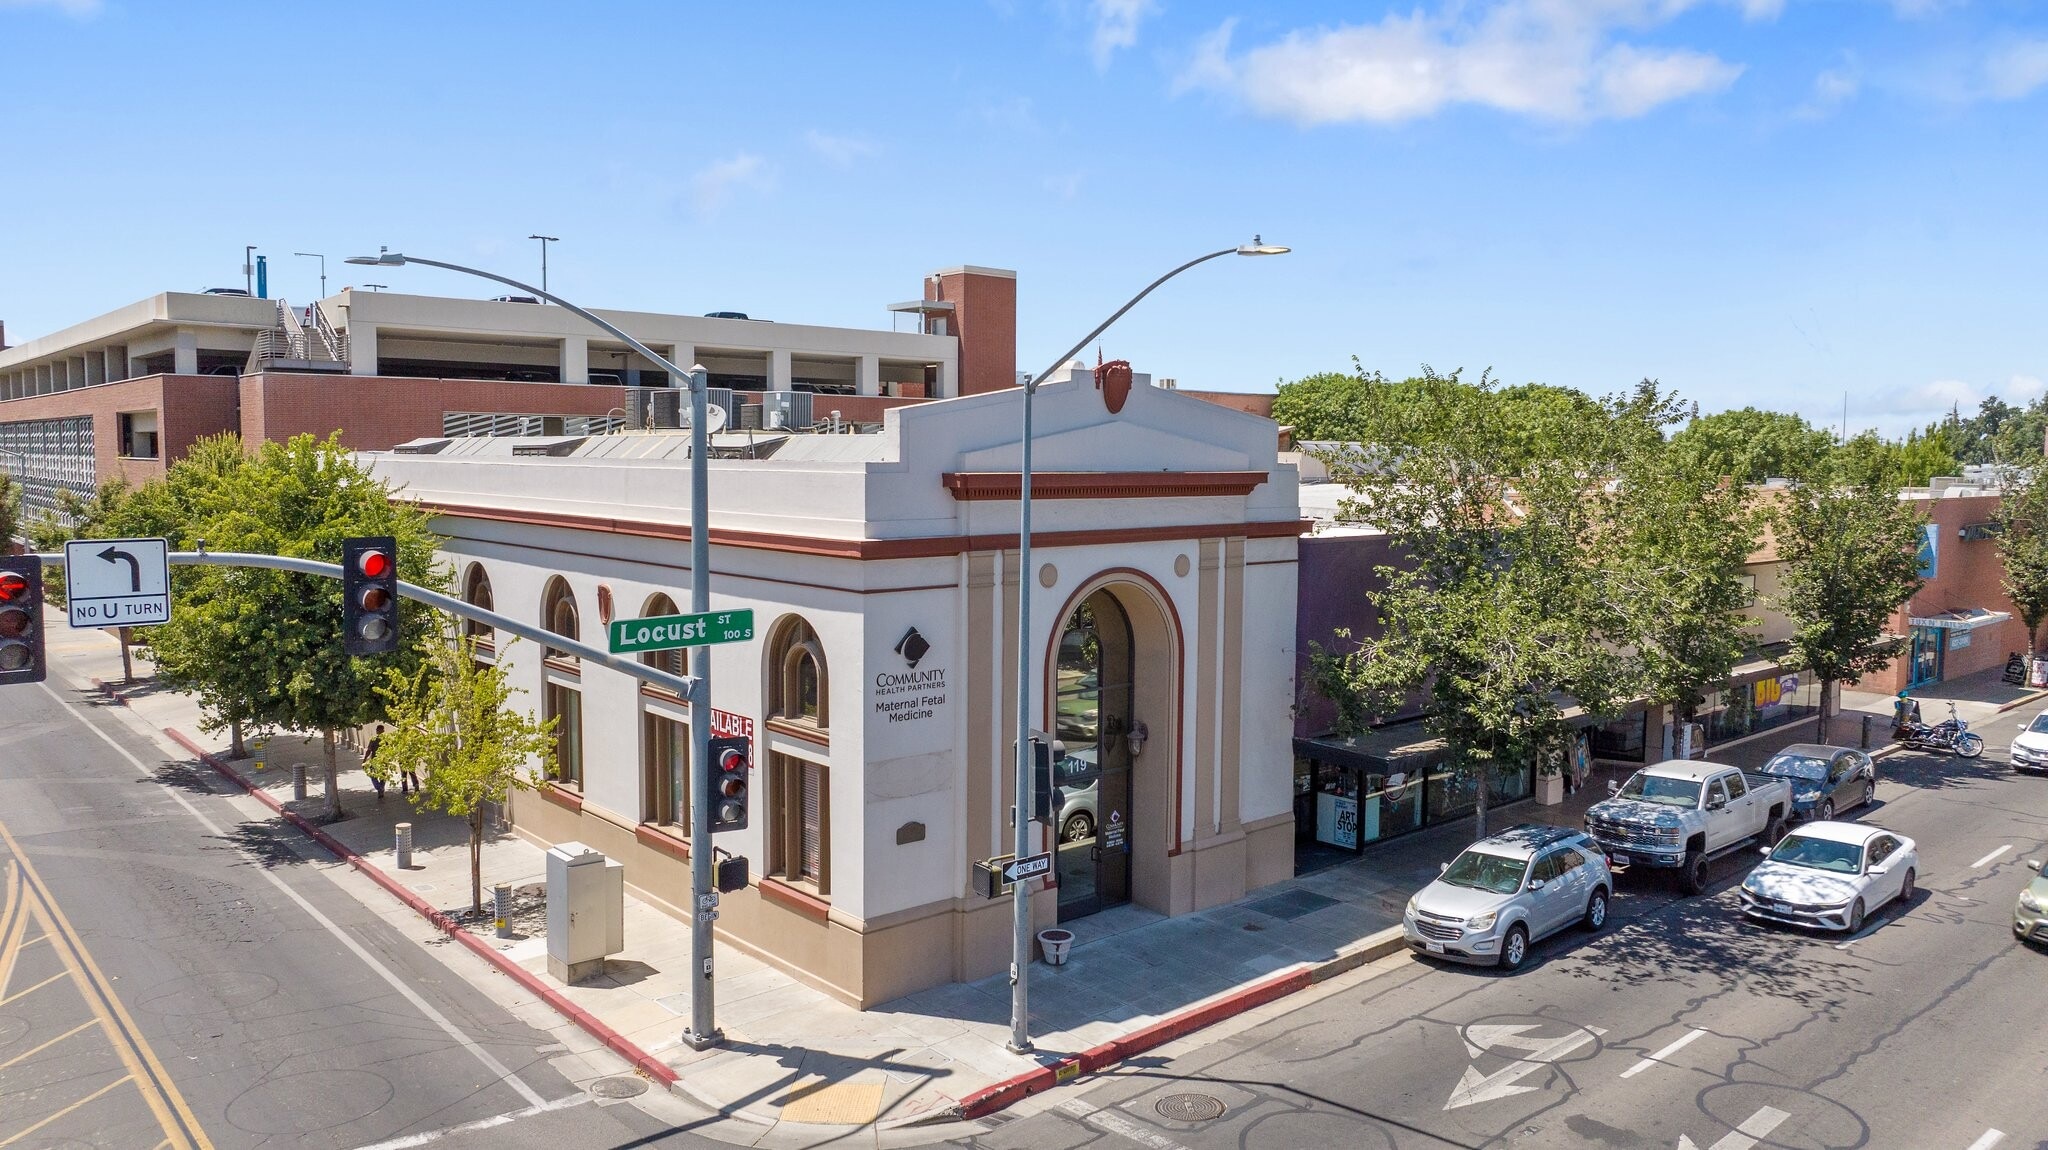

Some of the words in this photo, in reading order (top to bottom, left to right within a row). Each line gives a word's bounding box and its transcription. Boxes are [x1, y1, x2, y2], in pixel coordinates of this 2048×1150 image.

[77, 606, 97, 618] NO
[103, 602, 118, 619] U
[125, 602, 162, 615] TURN
[620, 617, 707, 646] Locust
[717, 614, 732, 624] ST
[723, 629, 741, 640] 100
[744, 628, 752, 638] S
[876, 668, 946, 688] COMMUNITY
[875, 686, 905, 696] HEALTH
[907, 681, 946, 692] PARTNERS
[875, 697, 919, 713] Maternal
[921, 694, 946, 707] Fetal
[889, 709, 933, 723] Medicine
[1068, 760, 1087, 774] 119
[1340, 810, 1355, 822] ART
[1336, 820, 1358, 834] STOP
[1016, 863, 1031, 875] ONE
[1032, 859, 1046, 871] WAY
